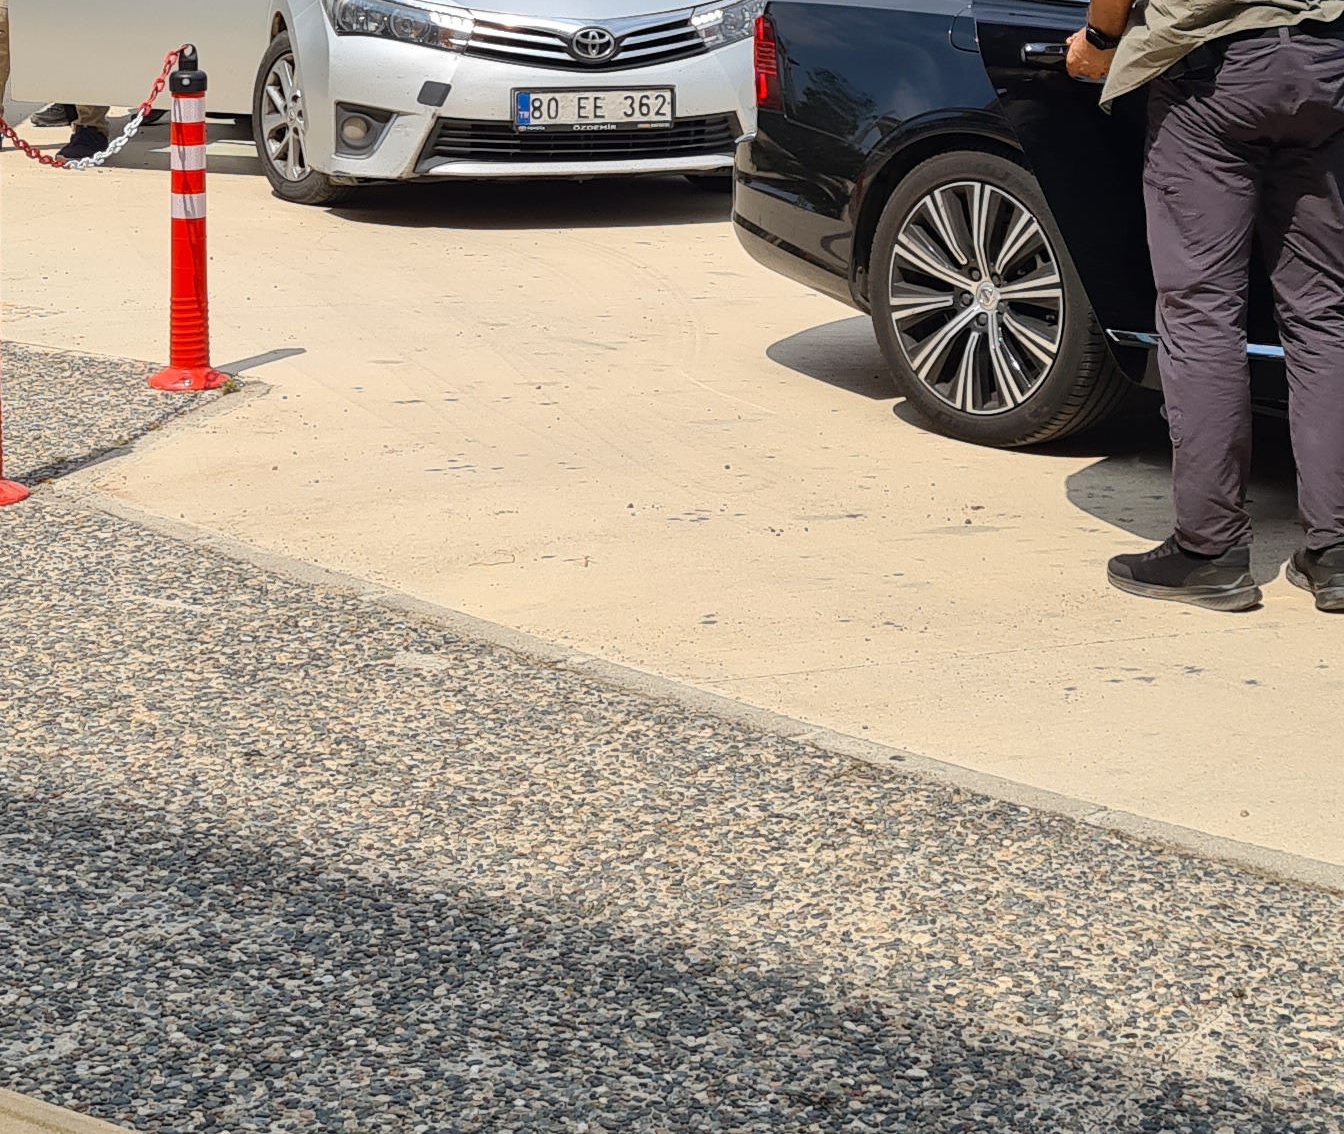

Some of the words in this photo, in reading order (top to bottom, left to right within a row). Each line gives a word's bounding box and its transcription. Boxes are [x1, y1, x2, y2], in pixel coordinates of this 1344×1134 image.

[531, 96, 559, 120] 80
[577, 96, 606, 119] EE
[623, 93, 667, 118] 362
